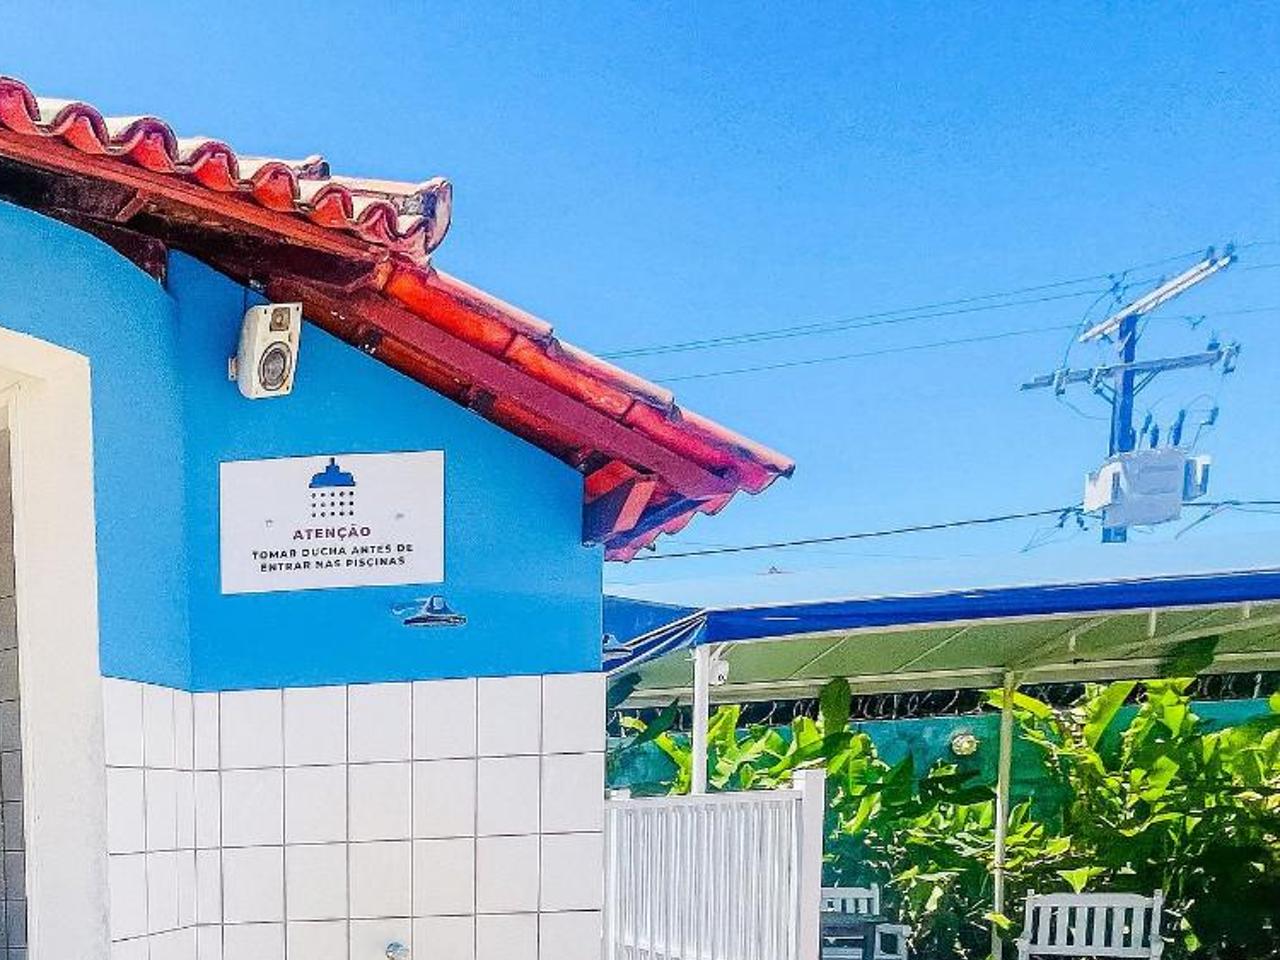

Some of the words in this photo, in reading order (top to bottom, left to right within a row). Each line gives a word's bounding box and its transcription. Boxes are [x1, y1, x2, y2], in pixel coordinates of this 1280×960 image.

[293, 524, 371, 541] ATENÇÃO
[252, 549, 297, 560] TOMAR
[302, 546, 347, 557] DUCHA
[351, 545, 392, 555] ANTES
[397, 543, 413, 553] DE
[261, 561, 310, 572] ENTRAR
[315, 559, 341, 569] NAS
[346, 556, 405, 567] PISCINAS
